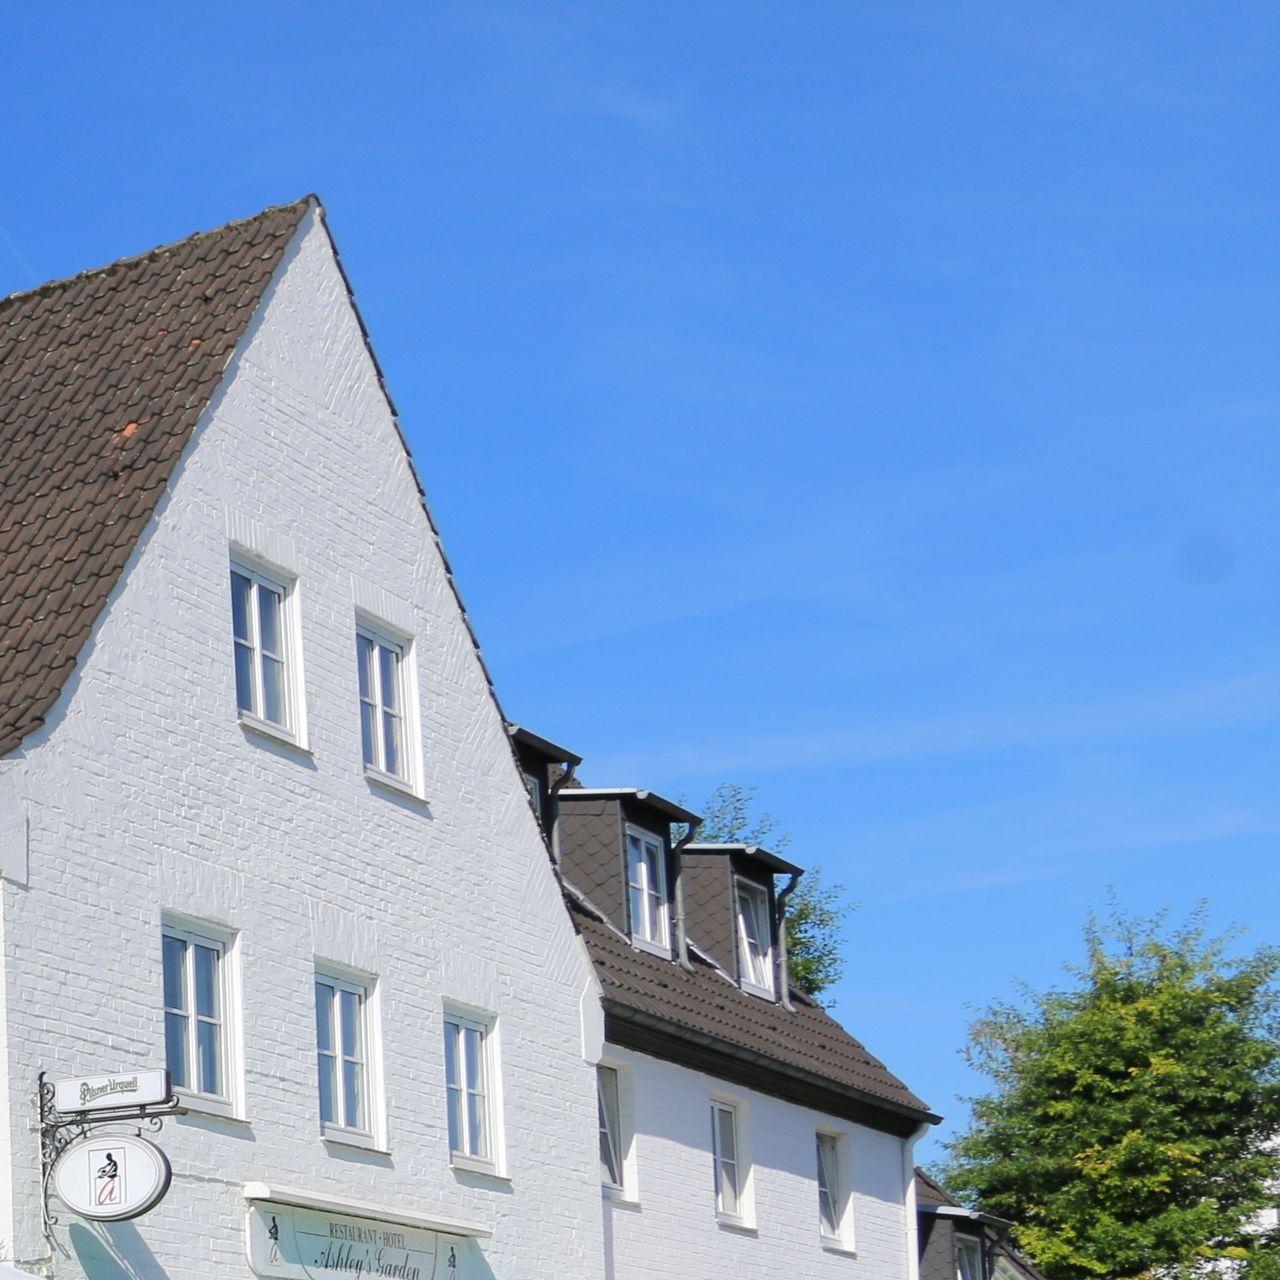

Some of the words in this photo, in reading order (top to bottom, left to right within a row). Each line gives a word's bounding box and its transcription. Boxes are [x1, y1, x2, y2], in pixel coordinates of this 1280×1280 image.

[80, 1082, 108, 1105] Pilsner
[108, 1076, 138, 1094] Urquell
[329, 1222, 378, 1246] RESTAURANT
[383, 1232, 407, 1250] HOTEL
